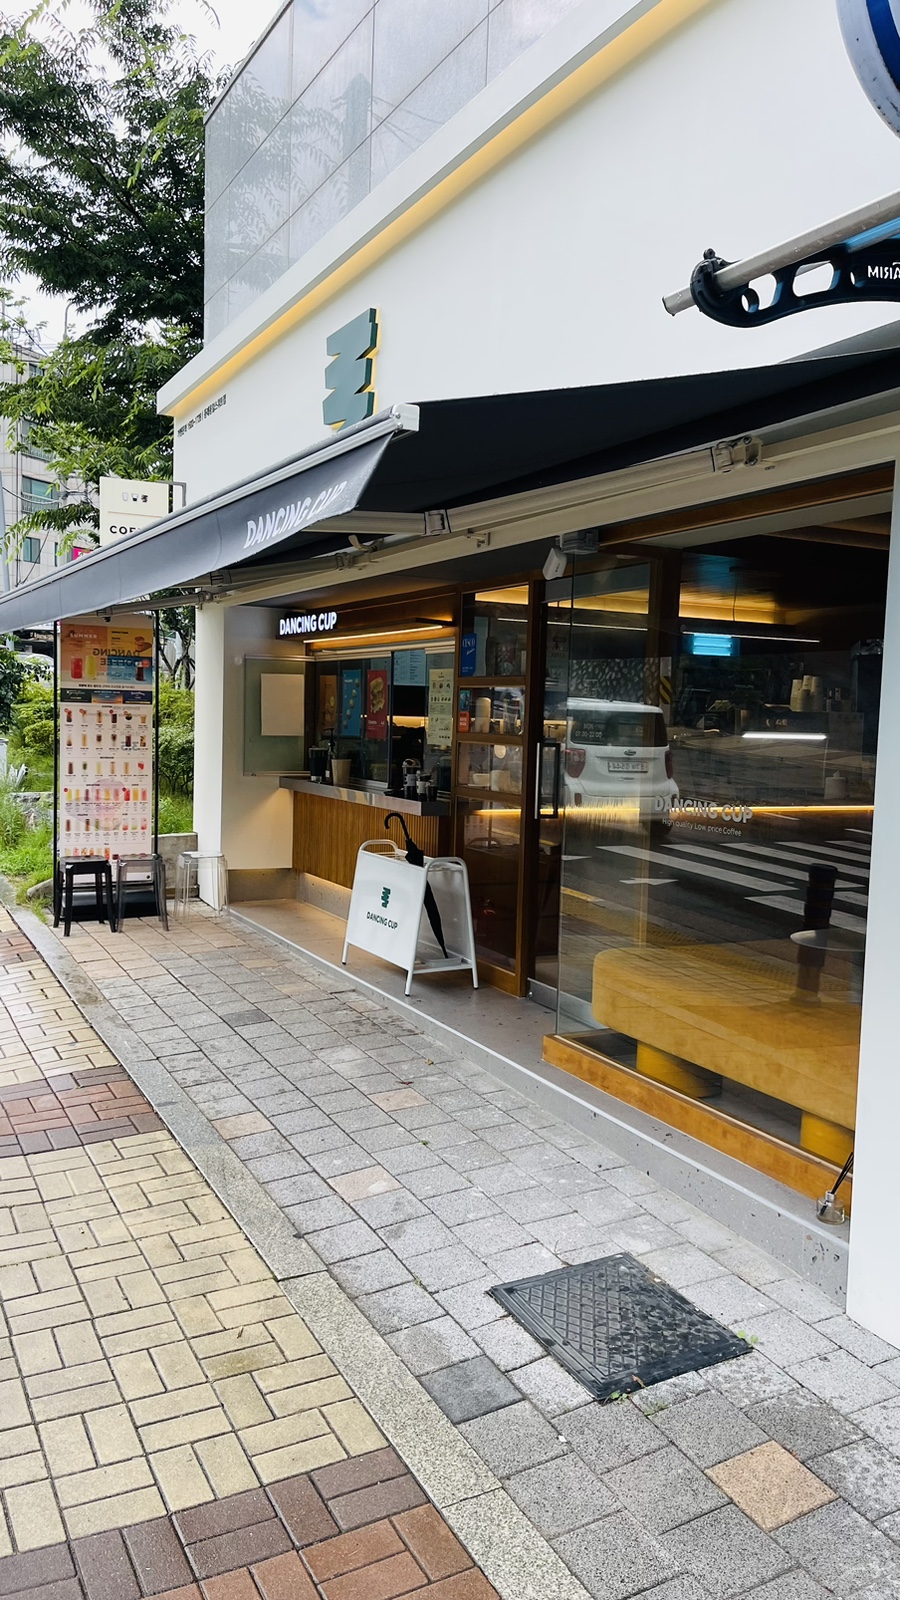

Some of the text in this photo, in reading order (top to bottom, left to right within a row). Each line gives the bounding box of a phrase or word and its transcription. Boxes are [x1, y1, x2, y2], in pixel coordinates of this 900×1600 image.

[243, 480, 347, 549] DANCING CUP
[279, 611, 337, 635] DANCING CUP
[654, 795, 753, 823] DANCING CUP
[662, 818, 742, 837] High quality Low price Coffee
[366, 911, 398, 930] DANCING CUP
